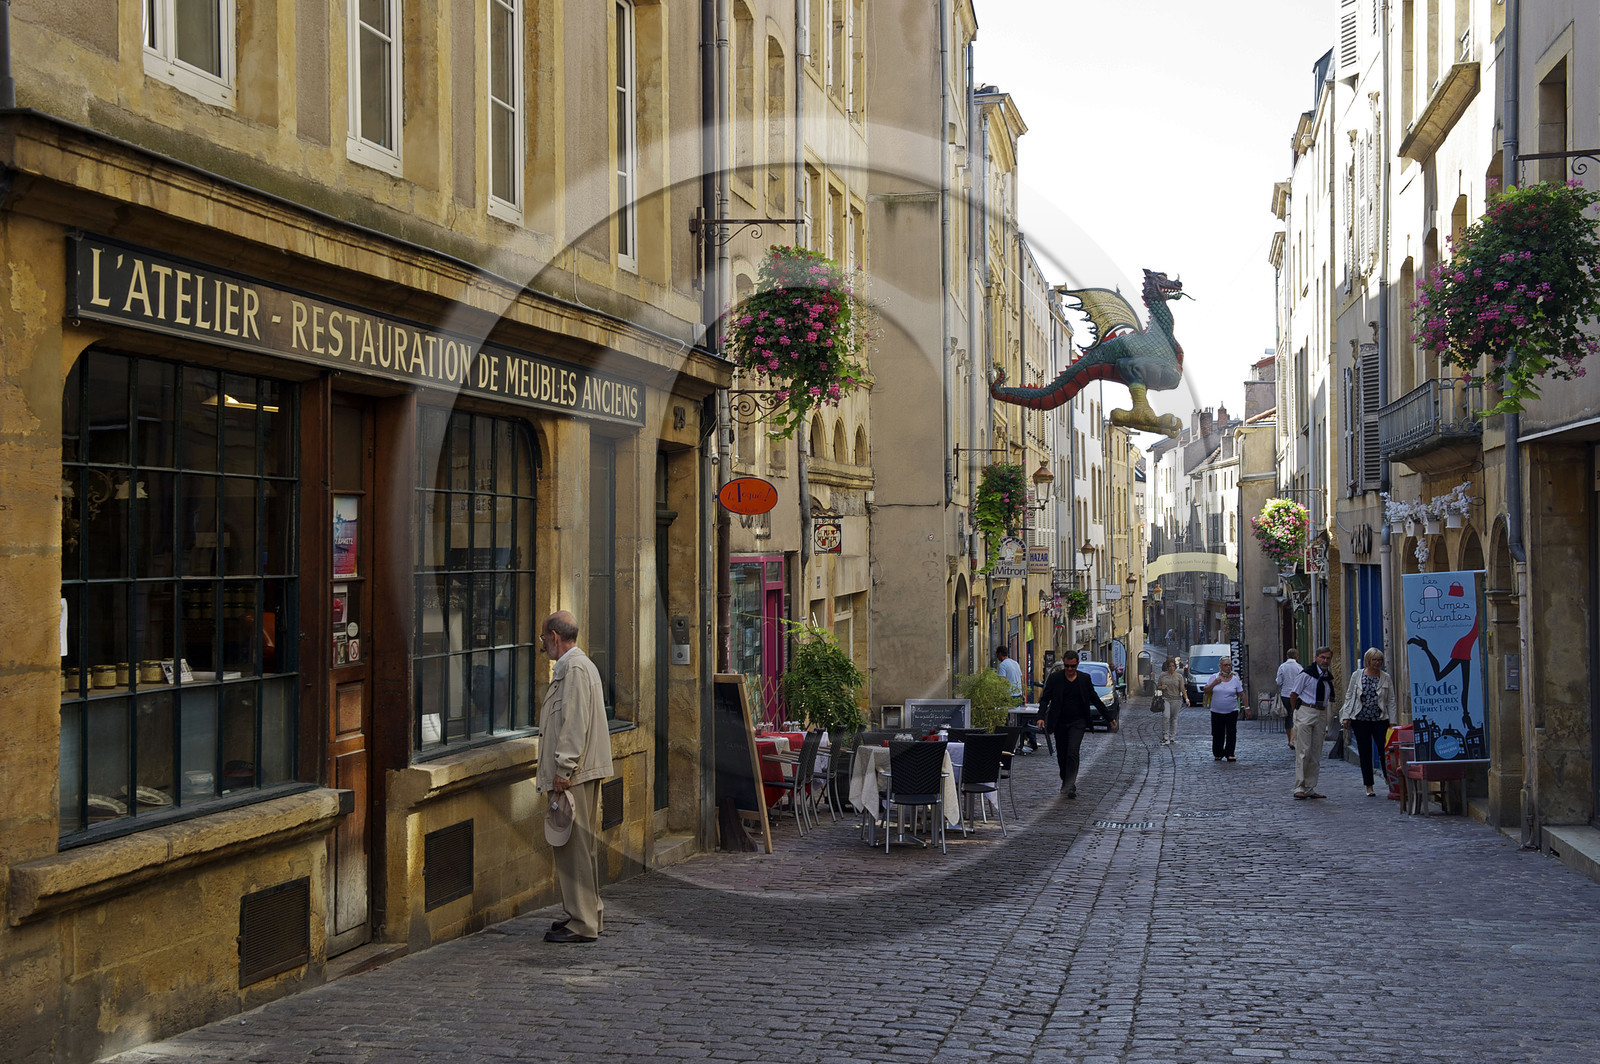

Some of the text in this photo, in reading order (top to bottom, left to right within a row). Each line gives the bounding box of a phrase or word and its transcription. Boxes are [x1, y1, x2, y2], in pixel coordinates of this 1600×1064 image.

[89, 246, 261, 341] L'ATELIER
[291, 299, 472, 384] RESTAURATION
[477, 352, 500, 392] DE
[504, 355, 578, 407] MEUBLES
[580, 375, 639, 420] ANCIENS
[1029, 552, 1049, 562] HAZAR
[995, 566, 1026, 576] Mitron
[1422, 575, 1438, 585] Les
[1409, 609, 1472, 629] Galantes
[1413, 681, 1458, 697] Mode
[1414, 696, 1459, 706] Chapeaux
[1414, 704, 1459, 714] Bijoux Déco
